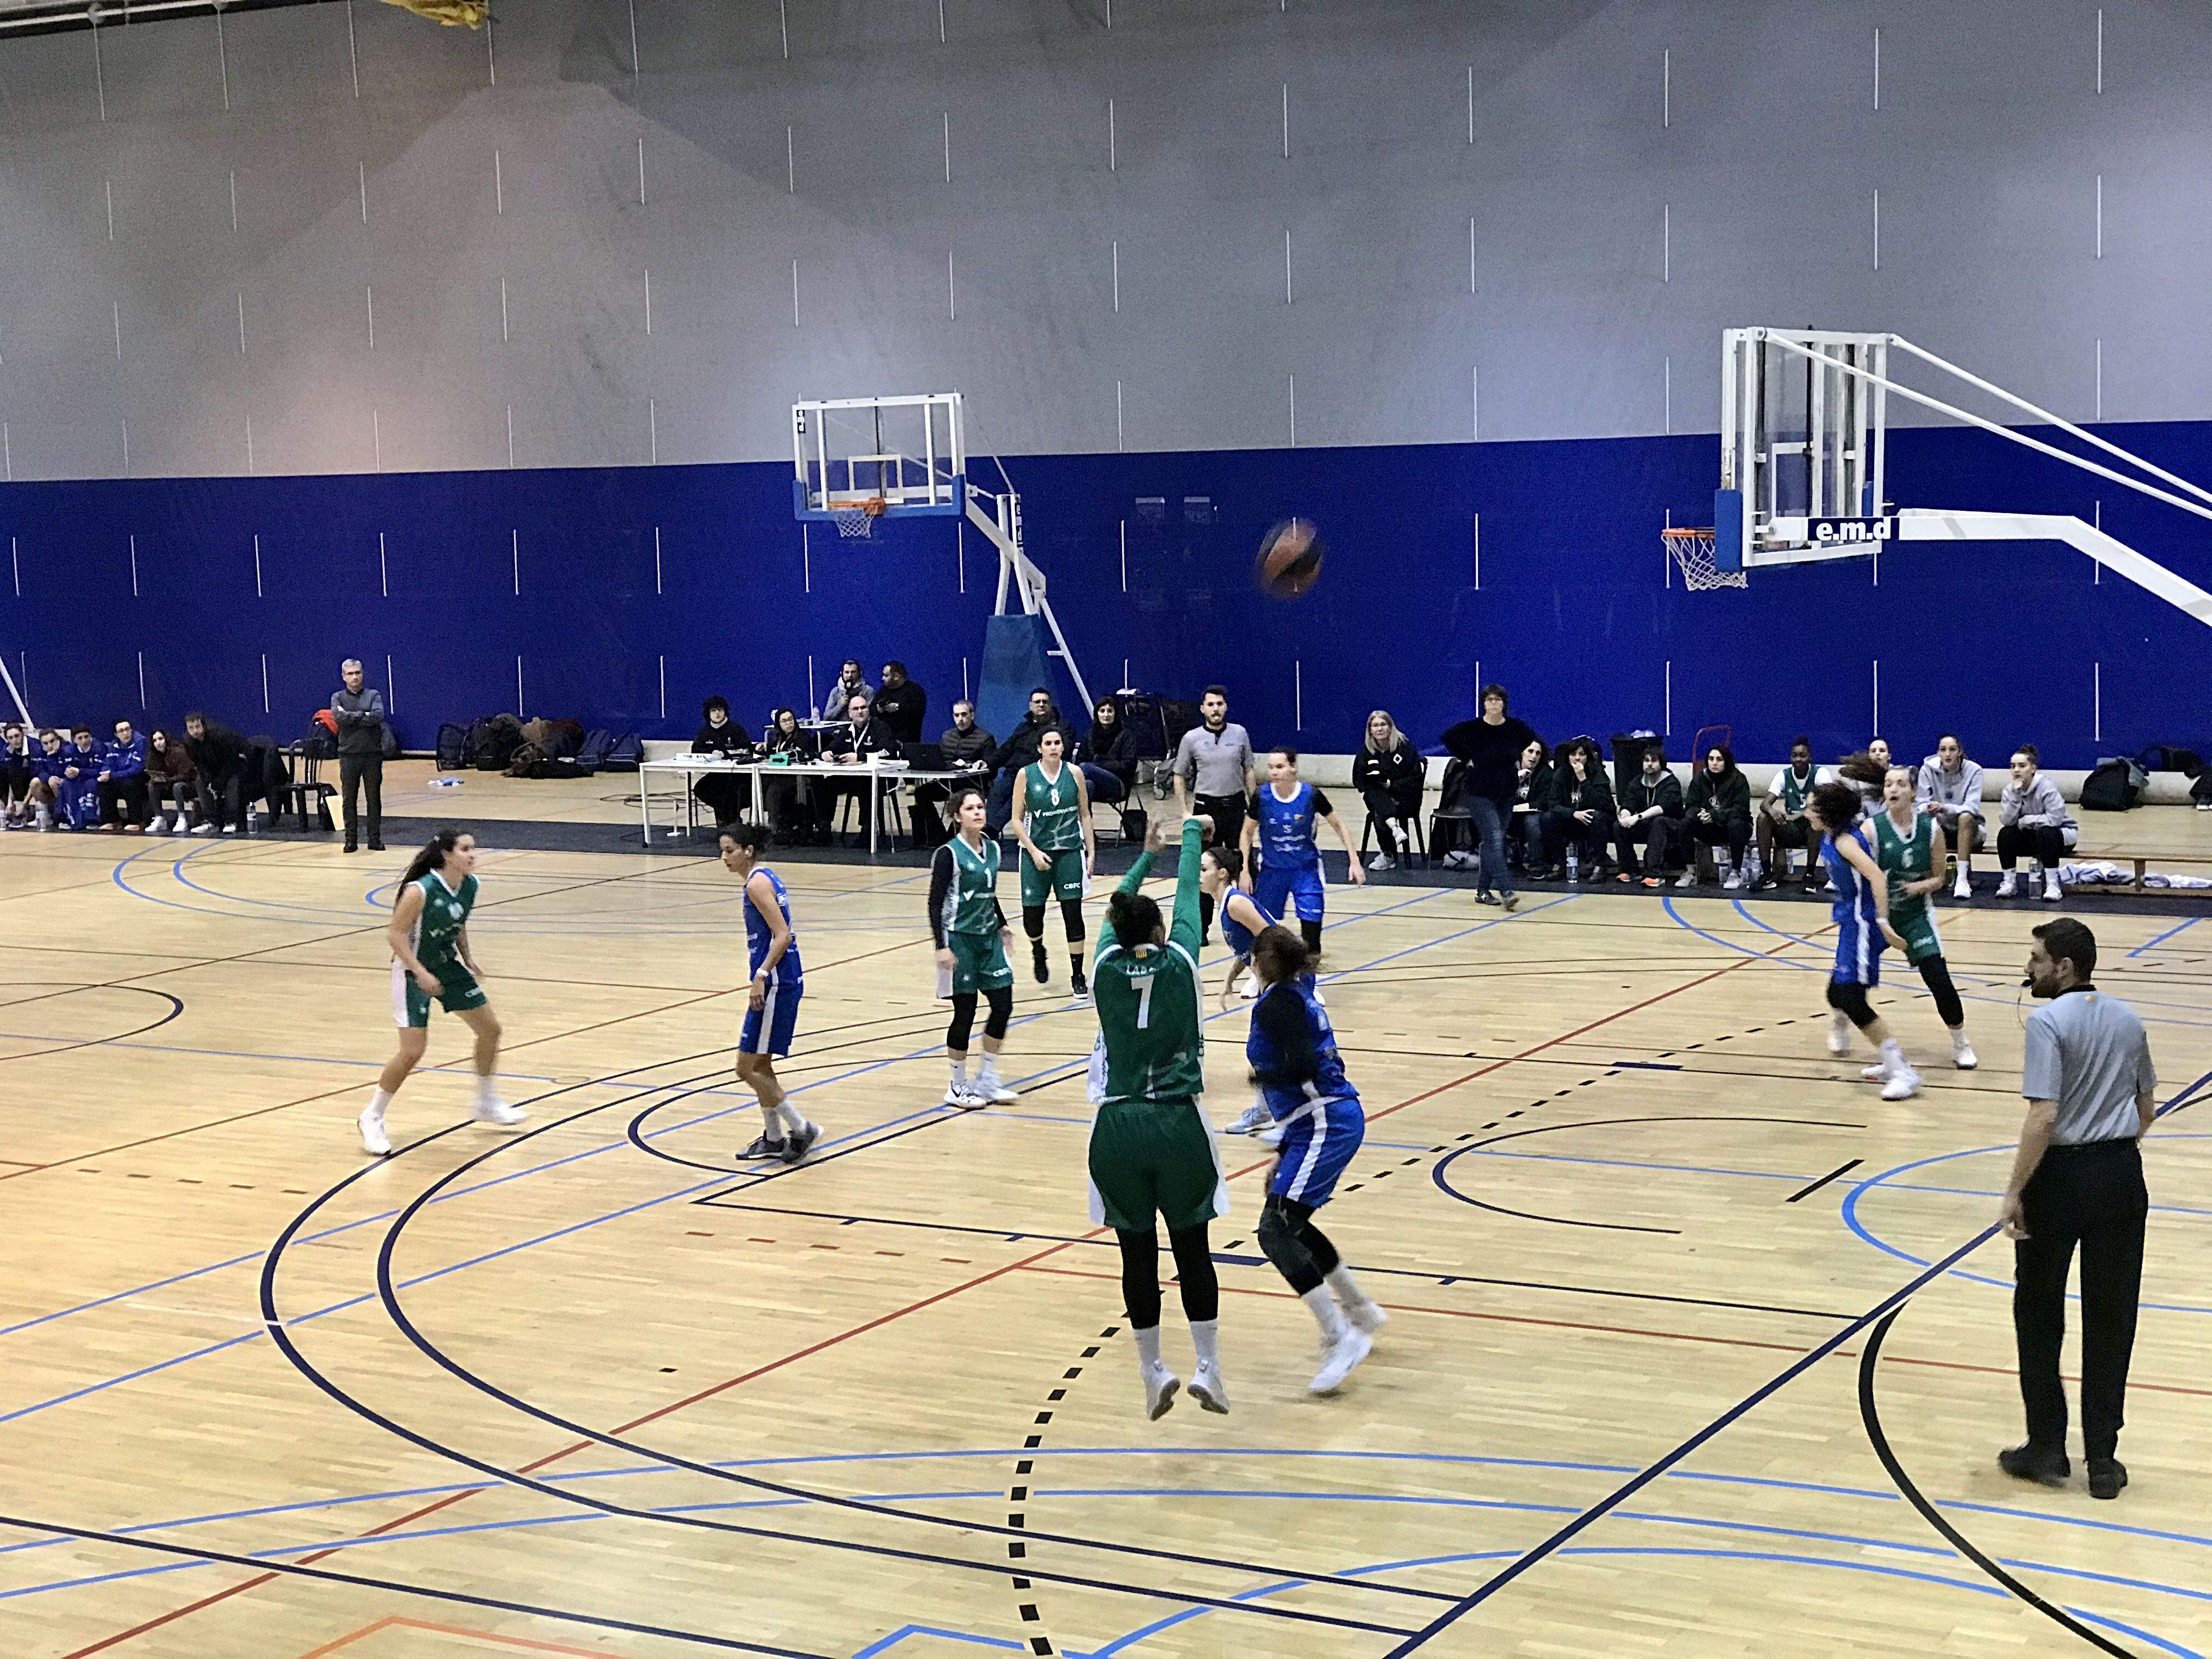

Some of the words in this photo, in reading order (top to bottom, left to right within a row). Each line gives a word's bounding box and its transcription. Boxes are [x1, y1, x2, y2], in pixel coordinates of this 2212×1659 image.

[1816, 518, 1891, 541] e.m.d
[1051, 788, 1060, 806] 8
[1130, 974, 1154, 1029] 7
